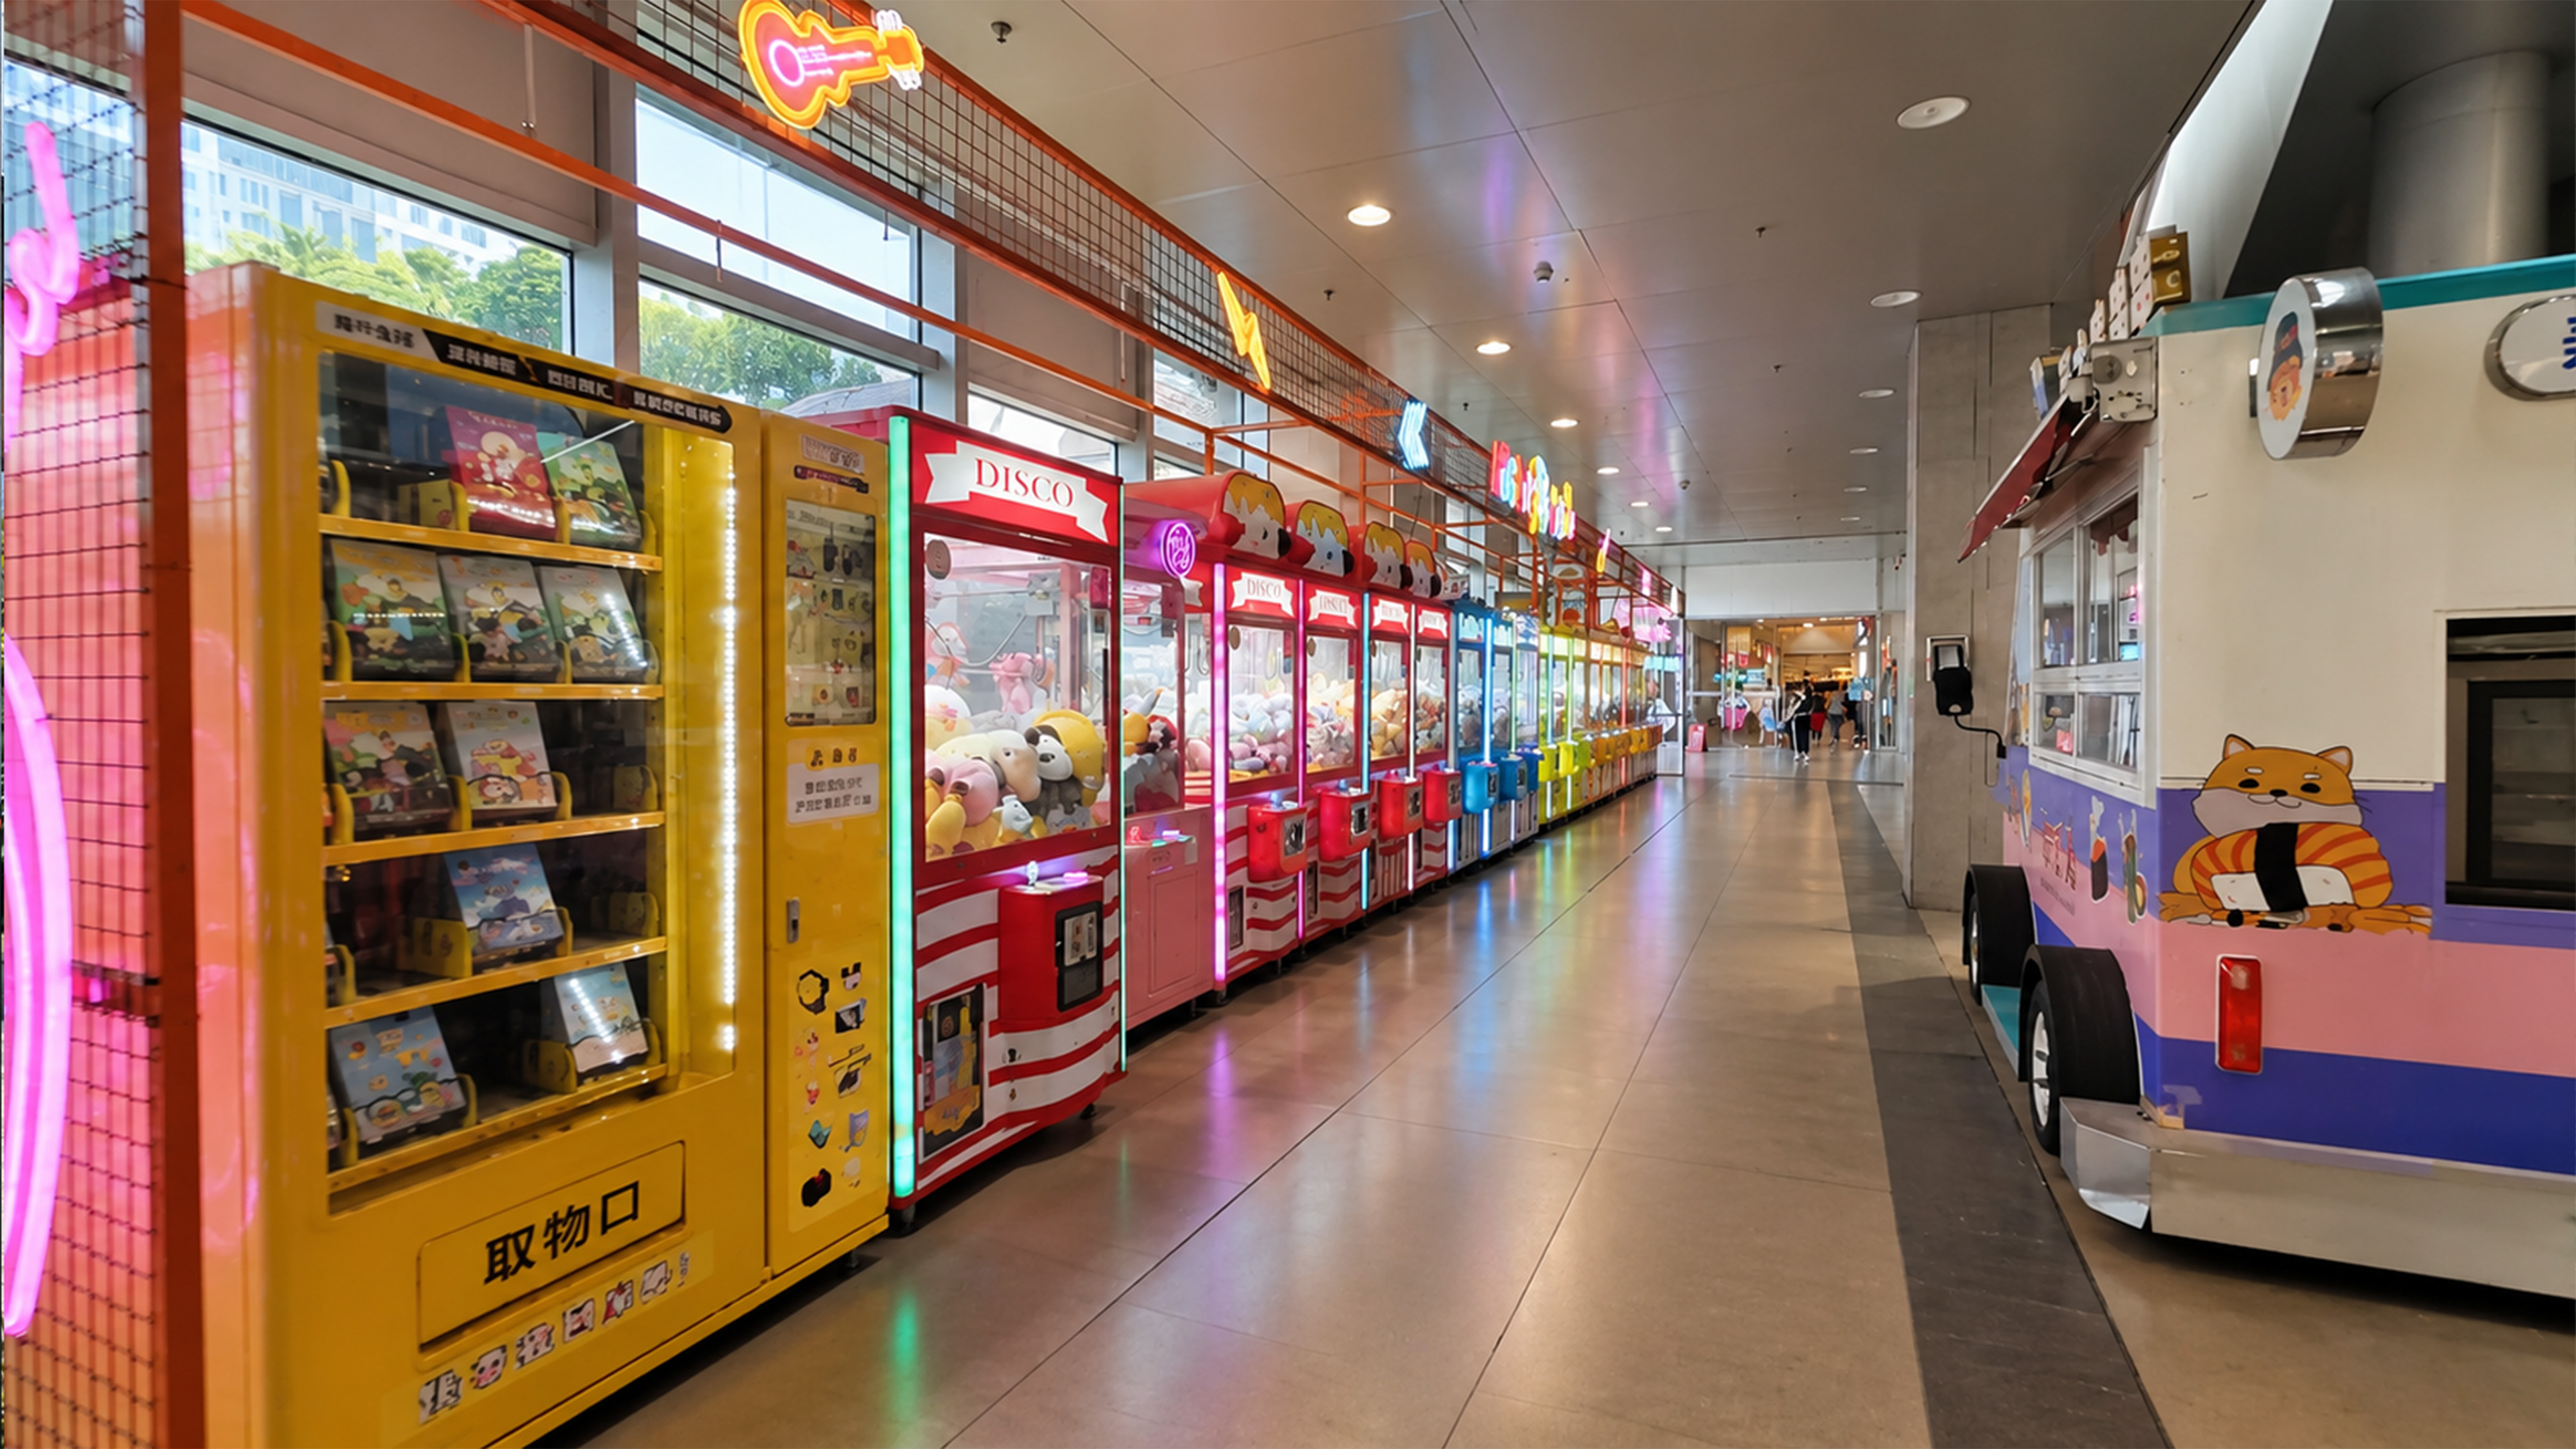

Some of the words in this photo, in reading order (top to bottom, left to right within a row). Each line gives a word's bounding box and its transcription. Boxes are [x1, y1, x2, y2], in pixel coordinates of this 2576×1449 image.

[975, 458, 1073, 508] DISCO
[1247, 578, 1281, 598] DISCO
[483, 1181, 640, 1285] 取物口
